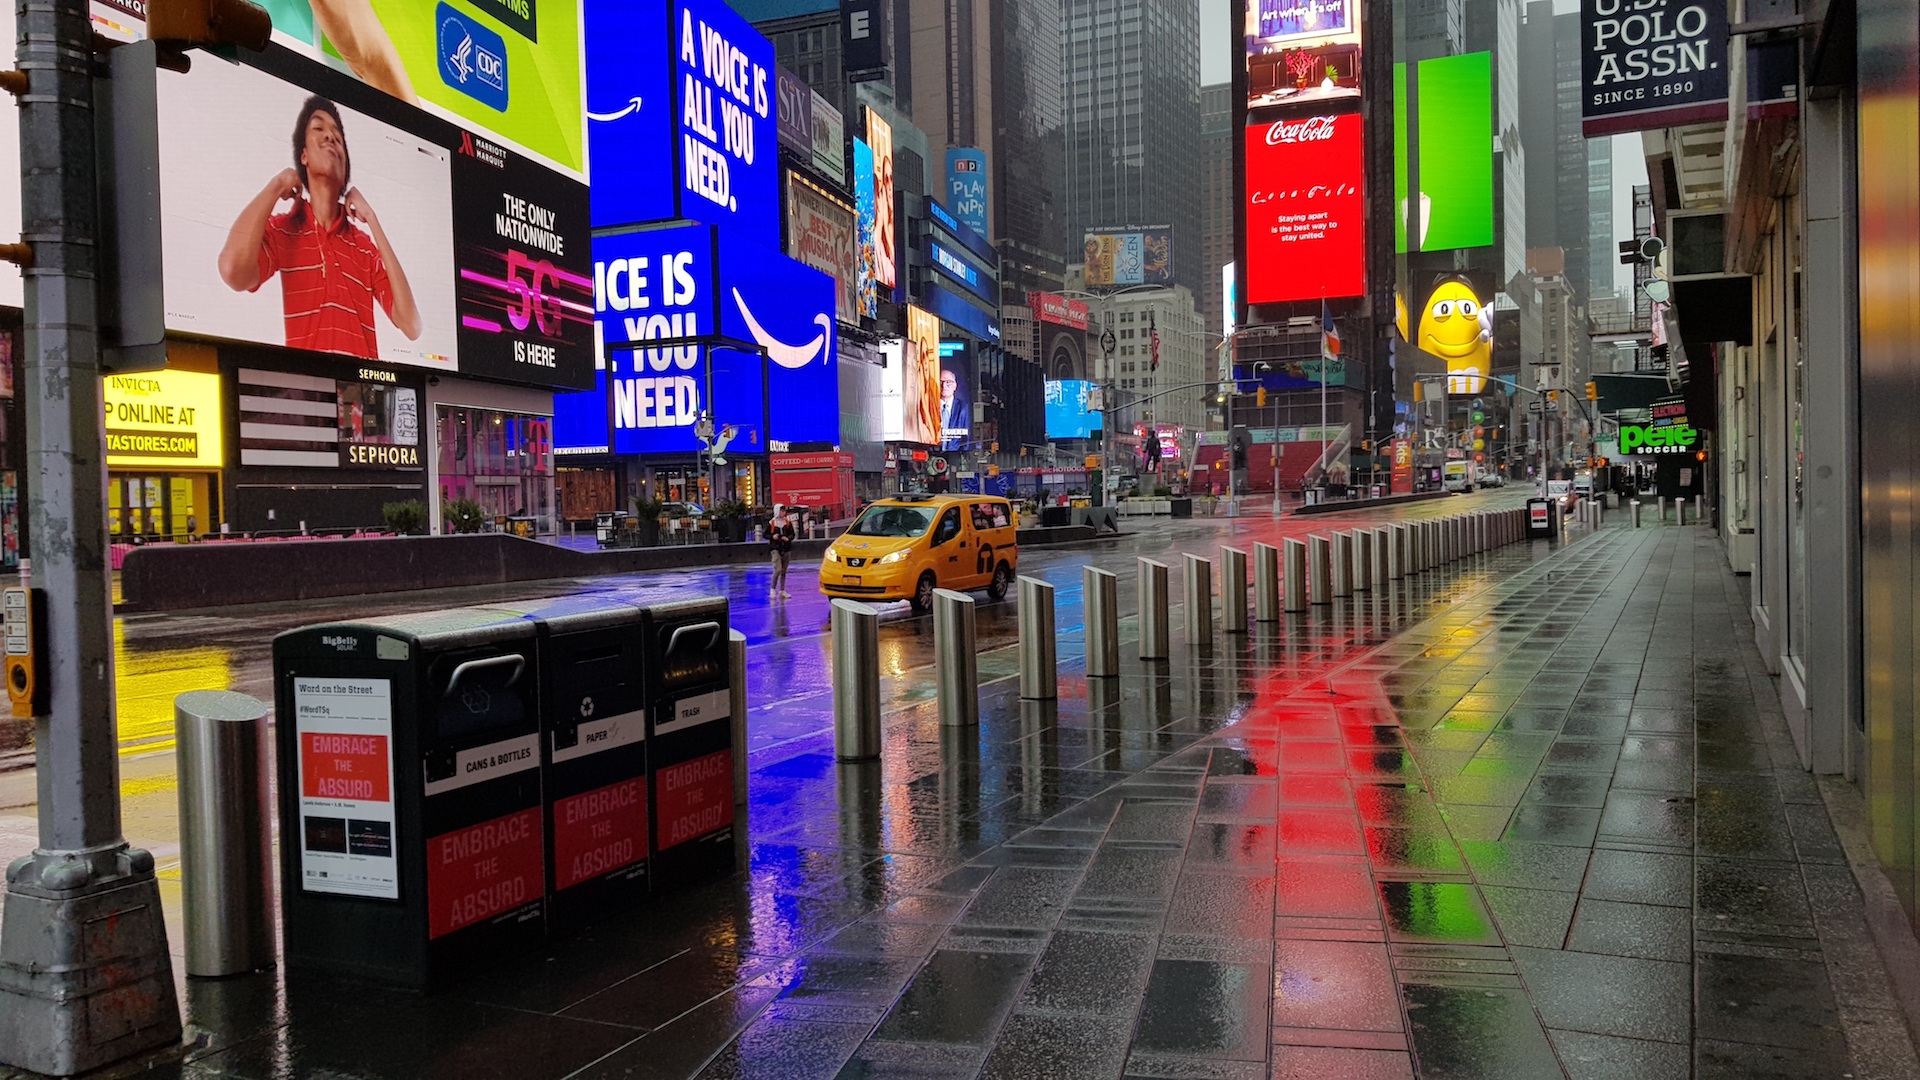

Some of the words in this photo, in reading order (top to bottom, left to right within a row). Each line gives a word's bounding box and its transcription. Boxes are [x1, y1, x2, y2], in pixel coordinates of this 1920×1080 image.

[850, 10, 869, 40] E
[1593, 5, 1706, 51] POLO
[477, 52, 502, 80] CDC
[681, 8, 696, 68] A
[699, 20, 750, 103] VOICE
[753, 63, 768, 118] IS
[1593, 39, 1718, 85] ASSN.
[1593, 88, 1645, 105] SINCE
[1653, 81, 1694, 97] 1890
[684, 74, 717, 143] ALL
[720, 97, 753, 165] YOU
[1265, 115, 1338, 146] Coca-Cola
[476, 139, 507, 159] MARRIOTT
[477, 150, 504, 169] MARQUIS
[684, 134, 737, 213] NEED.
[503, 193, 526, 221] THE
[528, 203, 555, 231] ONLY
[1278, 214, 1306, 223] Staying
[1307, 211, 1328, 221] apart
[496, 213, 563, 256] NATIONWIDE
[810, 213, 832, 242] BEST
[1281, 234, 1298, 242] stay
[1299, 231, 1325, 240] united.
[1294, 223, 1310, 231] best
[802, 233, 840, 266] MUSICAL
[1126, 236, 1140, 281] FROZEN
[507, 248, 562, 337] 5G
[661, 251, 696, 306] IS
[514, 340, 525, 363] IS
[526, 342, 556, 368] HERE
[625, 312, 698, 372] YOU
[112, 376, 161, 392] INVICTA
[359, 368, 396, 383] SEPHORA
[118, 402, 174, 425] ONLINE
[178, 407, 195, 426] AT
[349, 445, 418, 464] SEPHORA
[1637, 445, 1687, 454] SOCCER
[322, 636, 358, 646] BigBelly
[299, 684, 320, 692] Word
[333, 685, 346, 693] the
[348, 686, 373, 694] Street
[682, 707, 700, 719] TRASH
[312, 736, 377, 755] EMBRACE
[586, 730, 608, 744] PAPER
[334, 759, 353, 772] THE
[466, 758, 488, 773] CANS
[490, 756, 496, 767] &
[498, 747, 531, 765] BOTTLES
[666, 755, 724, 791] EMBRACE
[318, 778, 373, 798] ABSURD
[687, 788, 704, 806] THE
[566, 782, 637, 825] EMBRACE
[592, 820, 611, 839] THE
[671, 803, 721, 842] ABSURD
[442, 814, 530, 864] EMBRACE
[474, 856, 498, 880] THE
[572, 838, 633, 881] ABSURD
[451, 876, 525, 927] ABSURD
